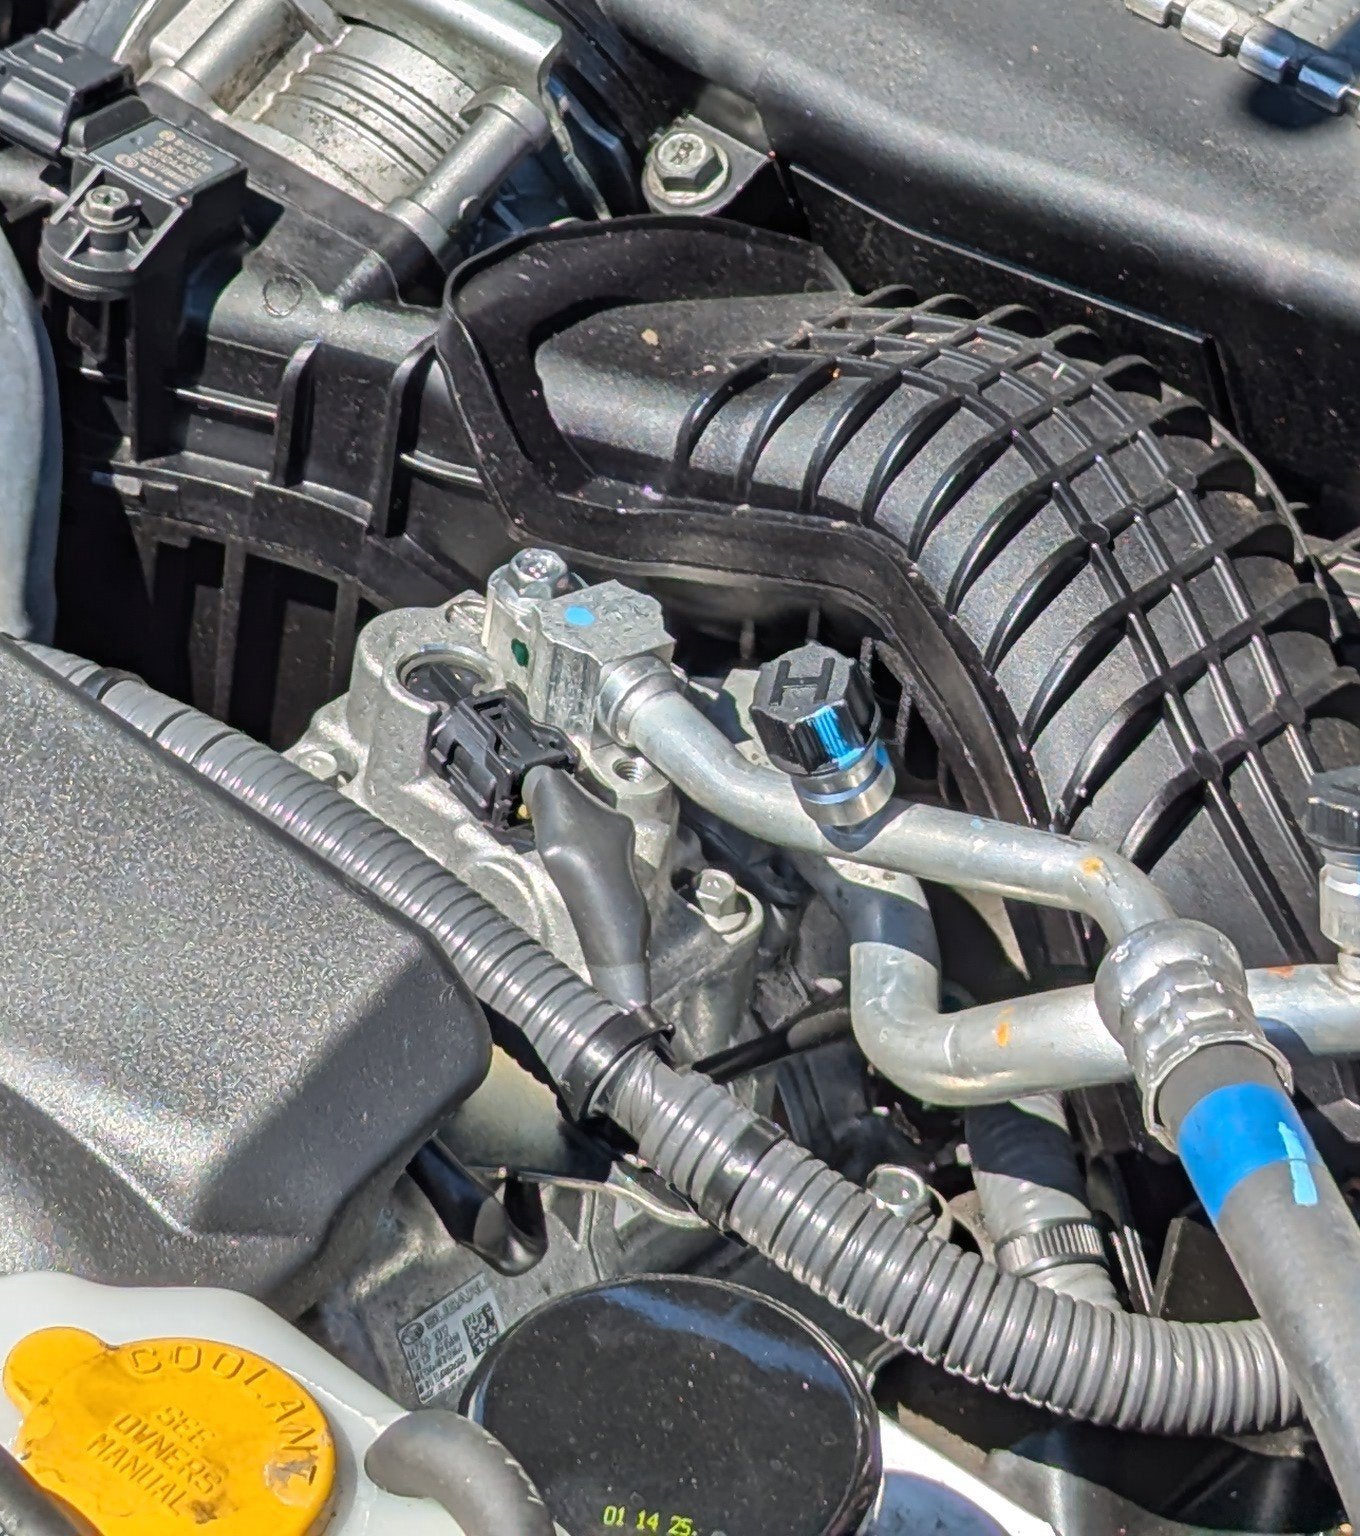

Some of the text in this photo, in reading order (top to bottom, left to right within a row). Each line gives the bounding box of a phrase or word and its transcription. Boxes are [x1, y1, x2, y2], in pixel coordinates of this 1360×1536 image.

[769, 657, 836, 706] H
[130, 1344, 319, 1486] COOLANT
[156, 1406, 217, 1451] SEE
[87, 1432, 188, 1518] MANUAL
[113, 1413, 223, 1495] OWNERS
[603, 1505, 626, 1527] 01
[636, 1509, 659, 1531] 14
